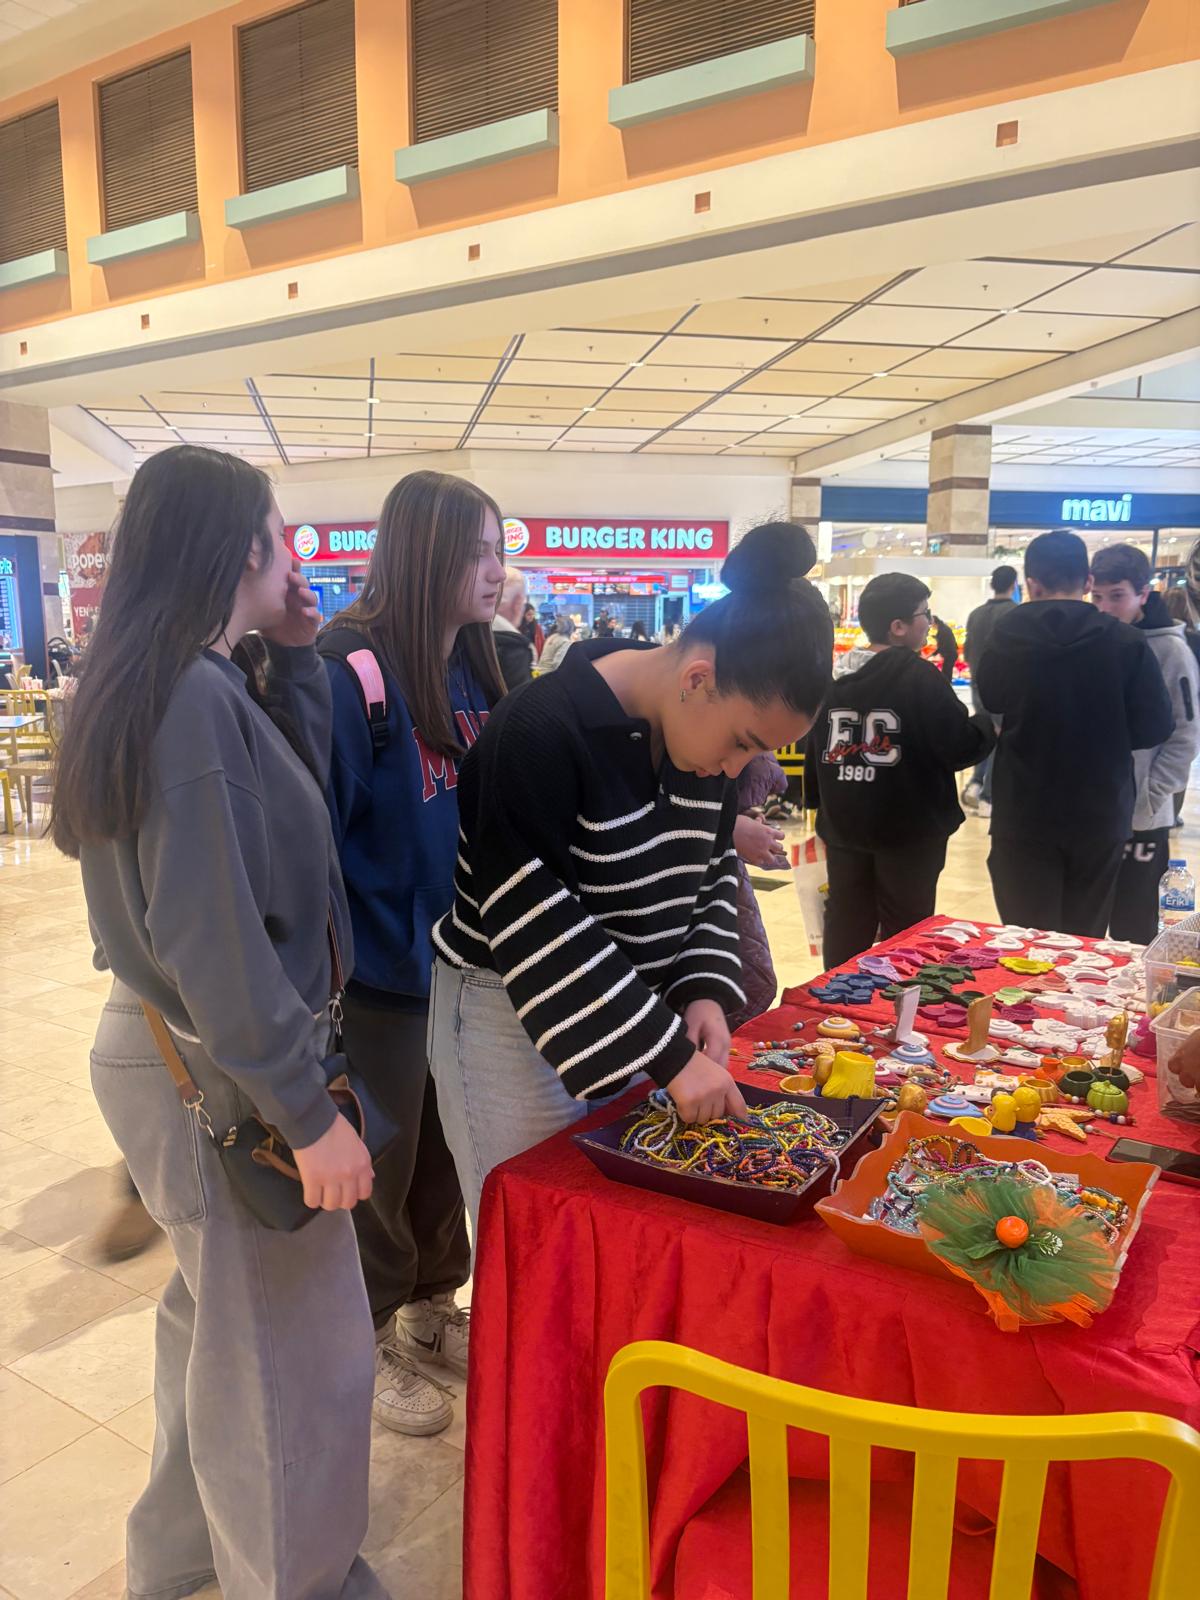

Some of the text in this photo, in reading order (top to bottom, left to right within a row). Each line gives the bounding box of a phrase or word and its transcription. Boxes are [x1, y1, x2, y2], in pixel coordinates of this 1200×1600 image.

[1062, 493, 1132, 521] mavi
[546, 526, 713, 550] BURGER KING
[837, 765, 876, 782] 1980
